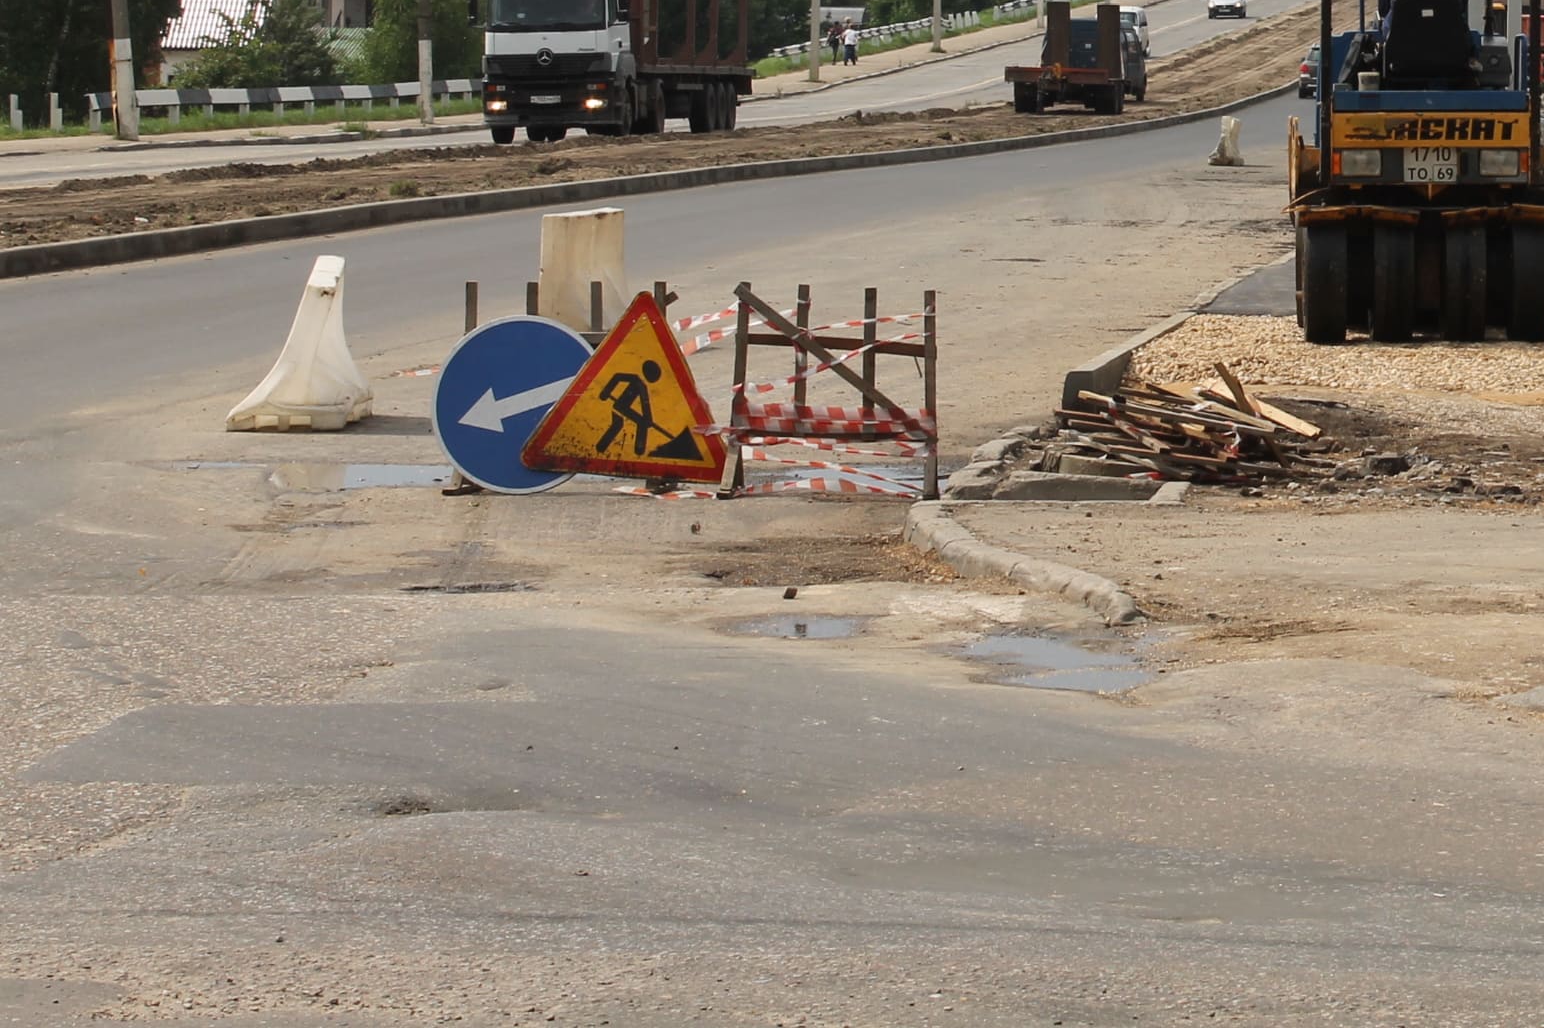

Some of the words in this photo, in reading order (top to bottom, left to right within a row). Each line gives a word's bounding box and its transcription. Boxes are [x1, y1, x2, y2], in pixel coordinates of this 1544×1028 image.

[1410, 147, 1451, 162] 1710
[1407, 167, 1428, 180] ТО
[1437, 167, 1454, 180] 69
